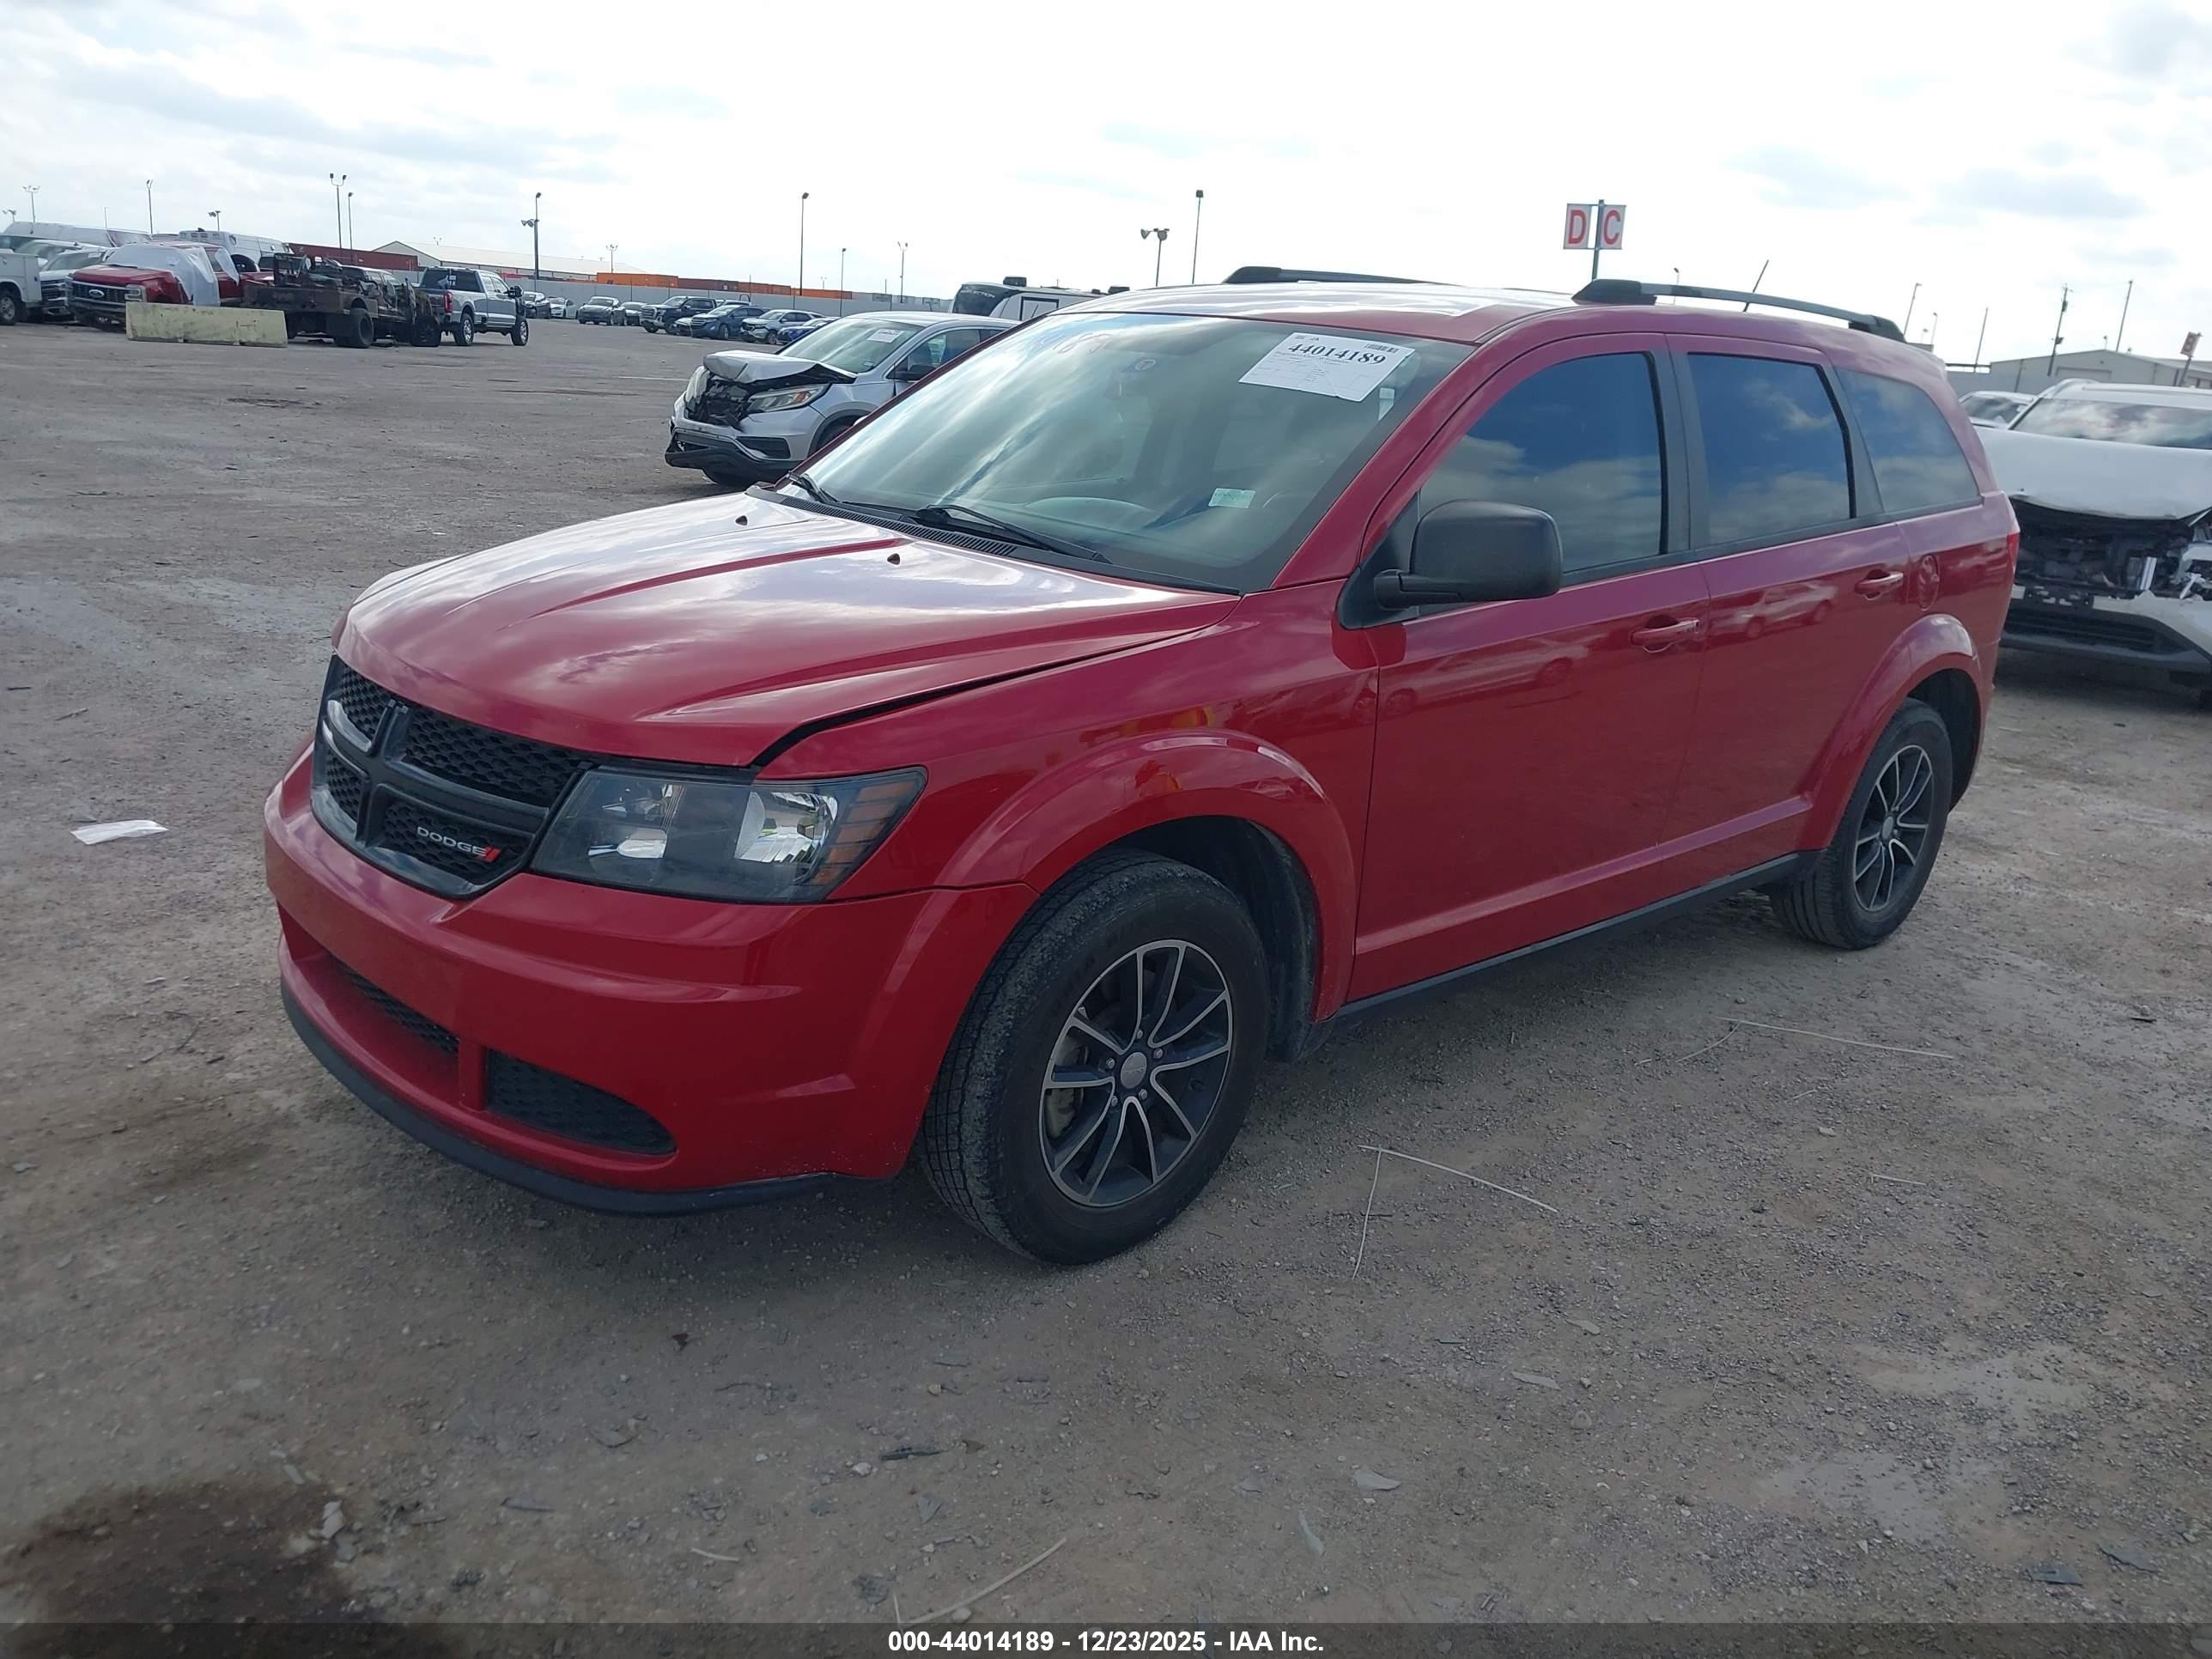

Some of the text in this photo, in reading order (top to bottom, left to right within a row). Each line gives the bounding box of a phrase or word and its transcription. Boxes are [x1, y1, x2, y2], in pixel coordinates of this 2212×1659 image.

[1568, 209, 1622, 246] D C
[1288, 343, 1386, 364] 44014189
[416, 826, 487, 857] DODGE
